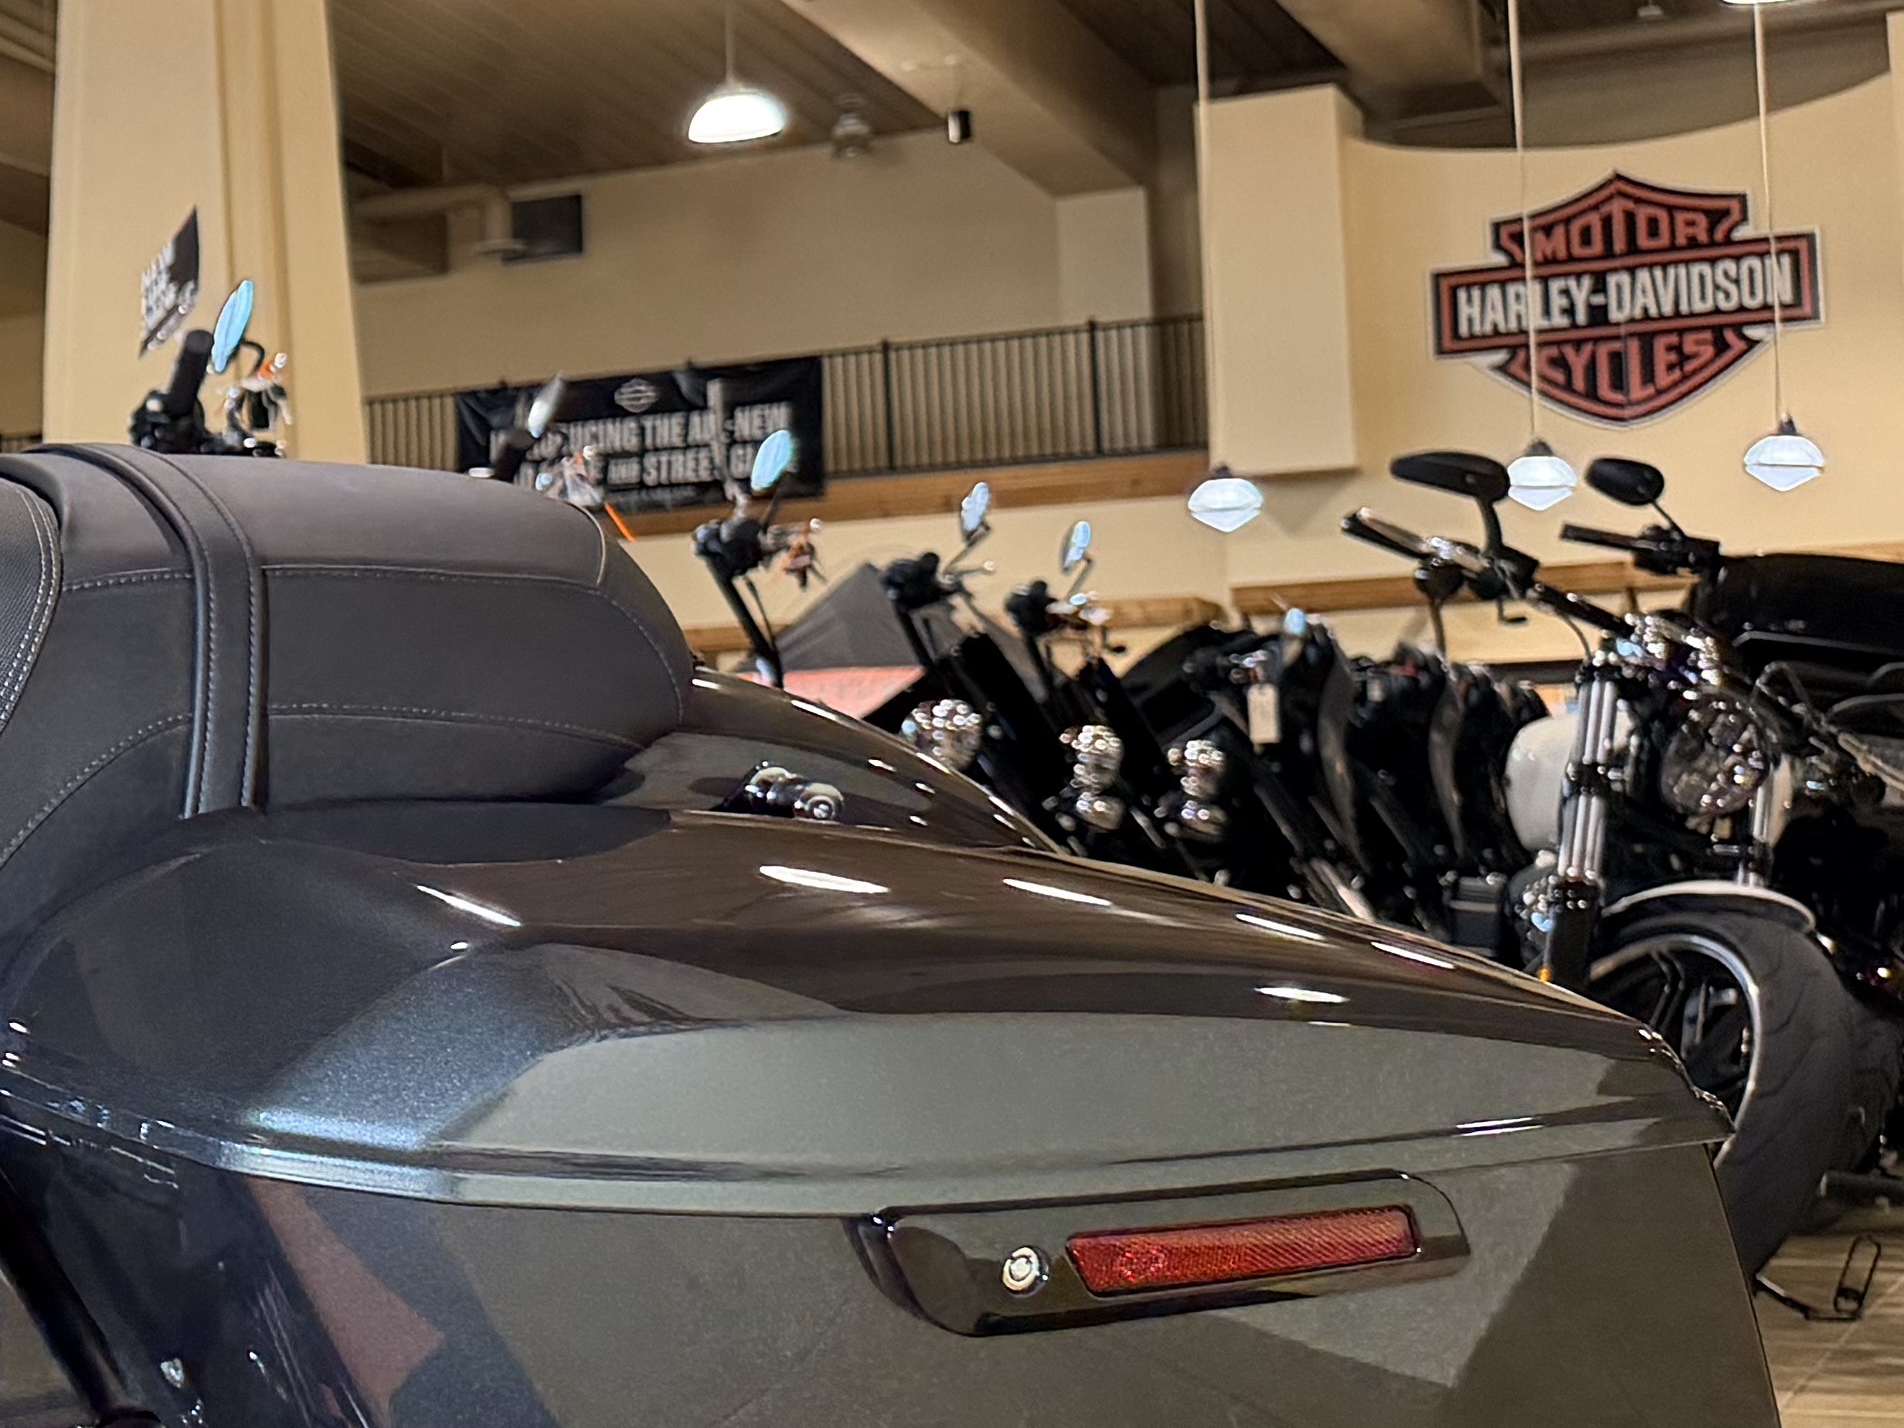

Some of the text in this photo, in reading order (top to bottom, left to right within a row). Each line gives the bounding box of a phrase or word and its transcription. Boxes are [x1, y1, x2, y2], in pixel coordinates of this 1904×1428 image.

[1534, 197, 1711, 264] MOTOR
[1456, 253, 1792, 338] HARLEY-DAVIDSON
[1536, 328, 1715, 404] CYCLES
